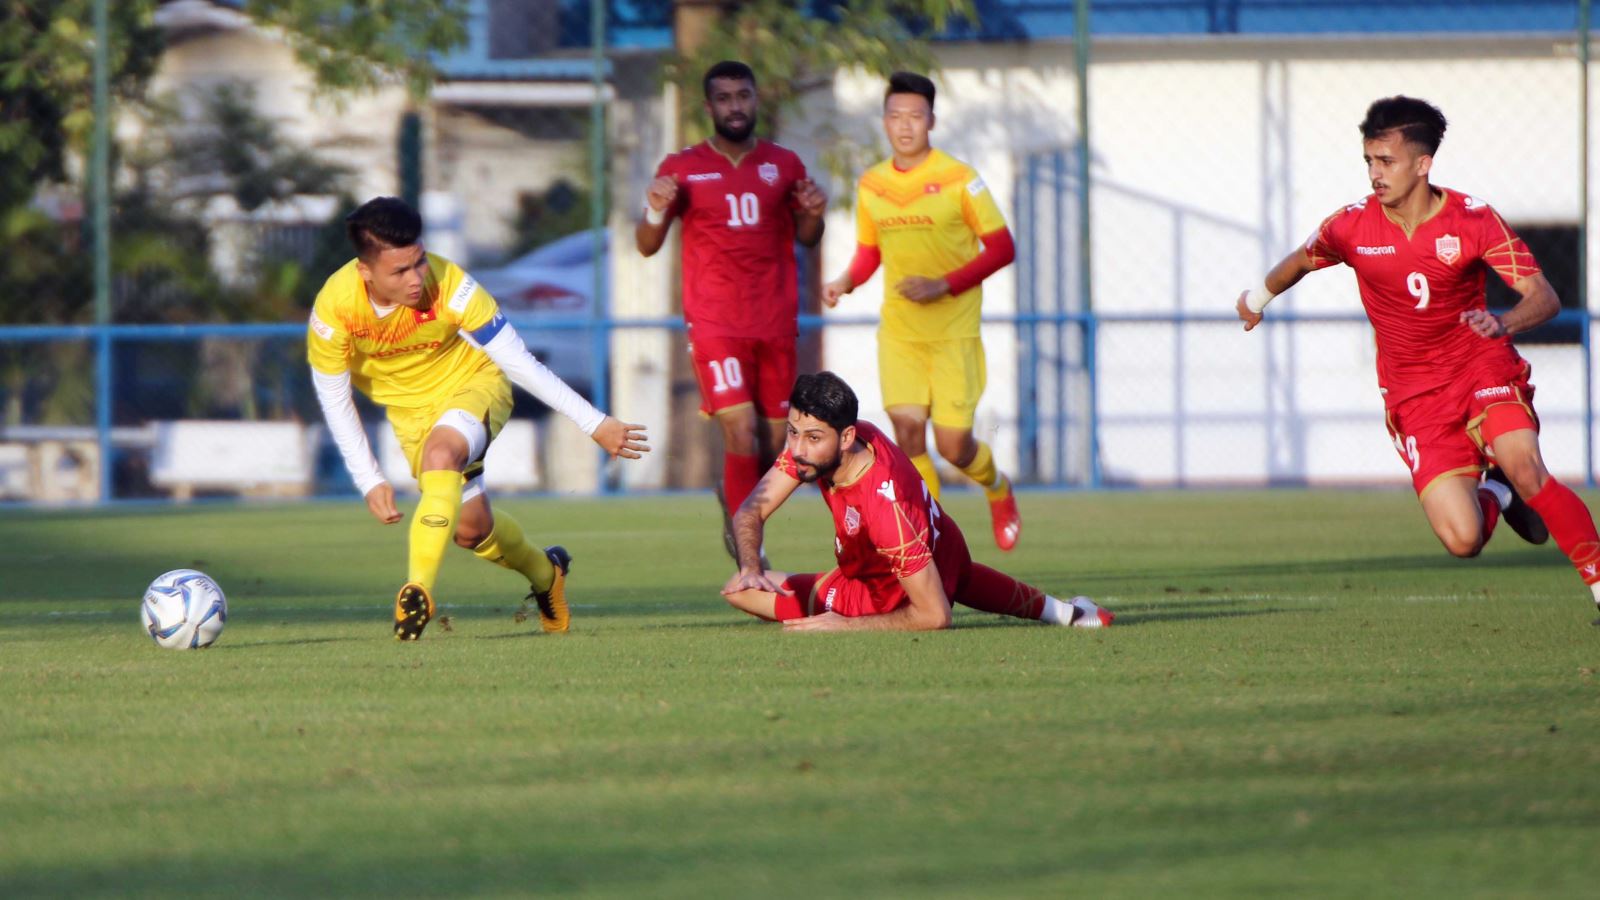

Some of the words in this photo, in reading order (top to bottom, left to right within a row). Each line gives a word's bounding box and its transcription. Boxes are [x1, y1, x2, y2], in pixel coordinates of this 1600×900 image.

[725, 192, 759, 226] 10
[1357, 246, 1395, 255] macron
[1407, 272, 1430, 309] 9
[709, 357, 742, 392] 10
[1475, 386, 1510, 399] macron
[1406, 436, 1420, 473] 9
